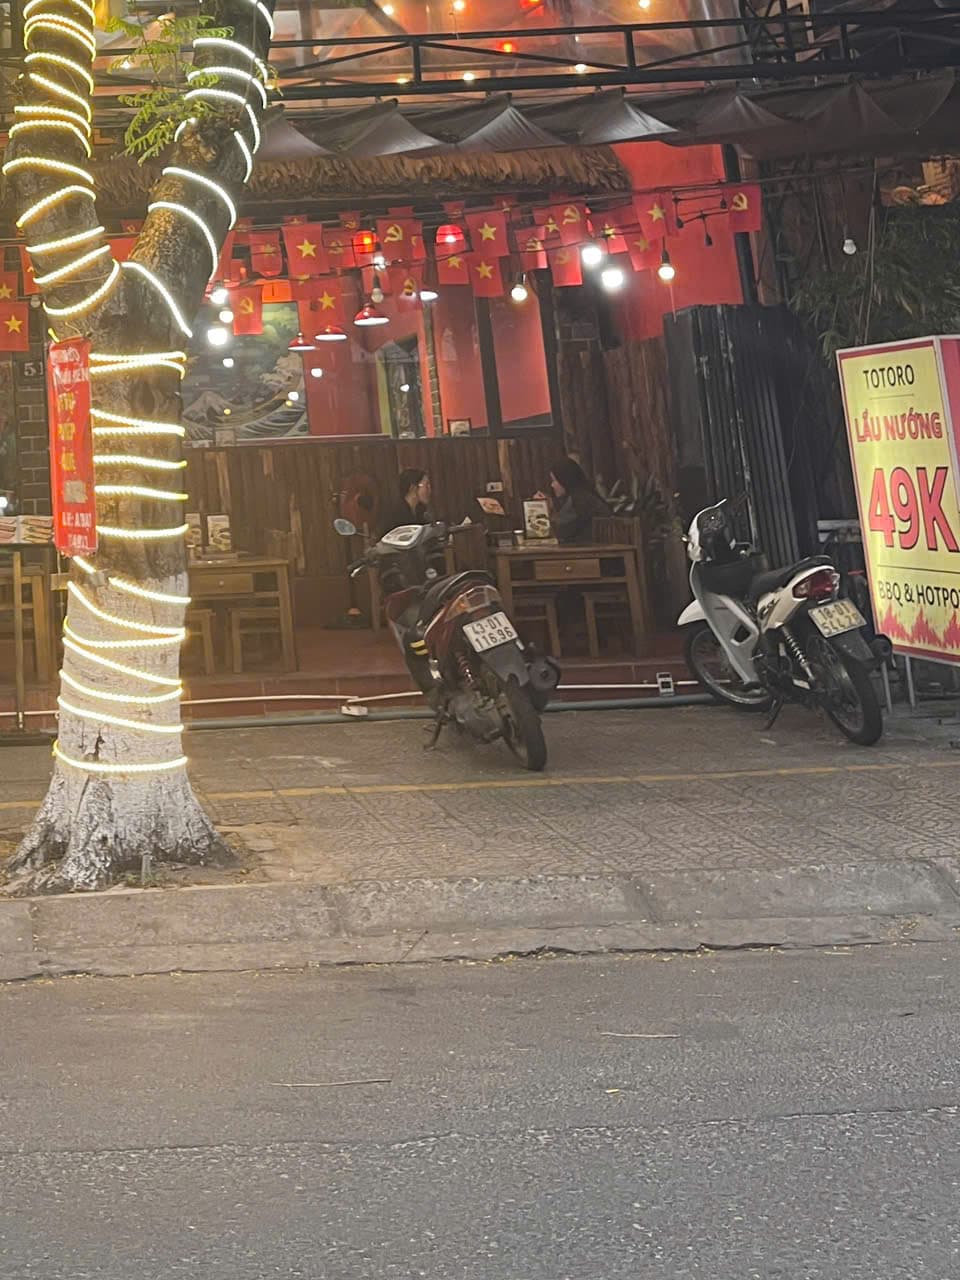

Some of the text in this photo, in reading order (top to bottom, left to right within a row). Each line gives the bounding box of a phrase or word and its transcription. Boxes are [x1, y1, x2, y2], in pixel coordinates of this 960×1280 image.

[863, 364, 915, 390] TOTORO
[883, 407, 943, 441] NƯỚNG
[869, 467, 960, 552] 49K
[878, 580, 960, 609] BBQ & HOTPO
